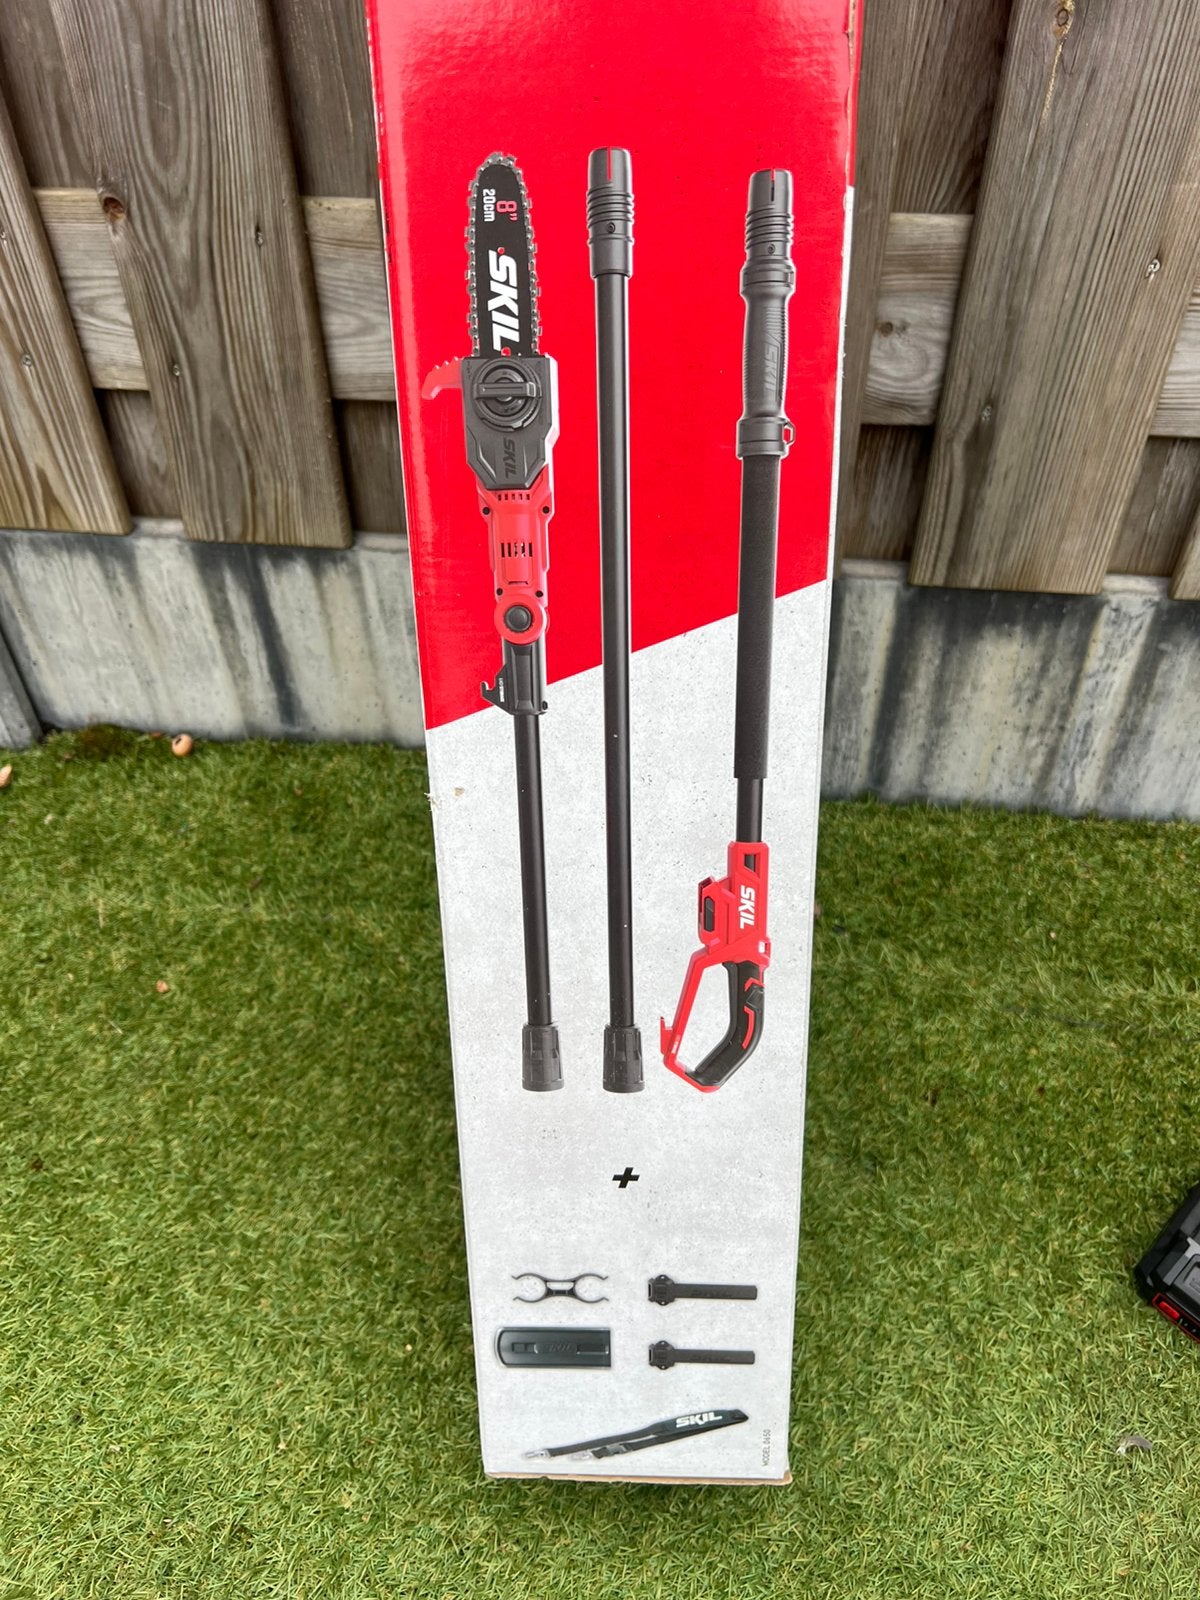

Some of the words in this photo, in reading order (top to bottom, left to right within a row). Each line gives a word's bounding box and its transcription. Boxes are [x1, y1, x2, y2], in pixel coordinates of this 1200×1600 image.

[483, 188, 496, 222] 20cm
[487, 250, 520, 352] SKIL
[502, 436, 517, 479] SKIL
[738, 884, 756, 930] SKIL
[676, 1411, 723, 1428] SKIL
[761, 1445, 770, 1467] MODEL
